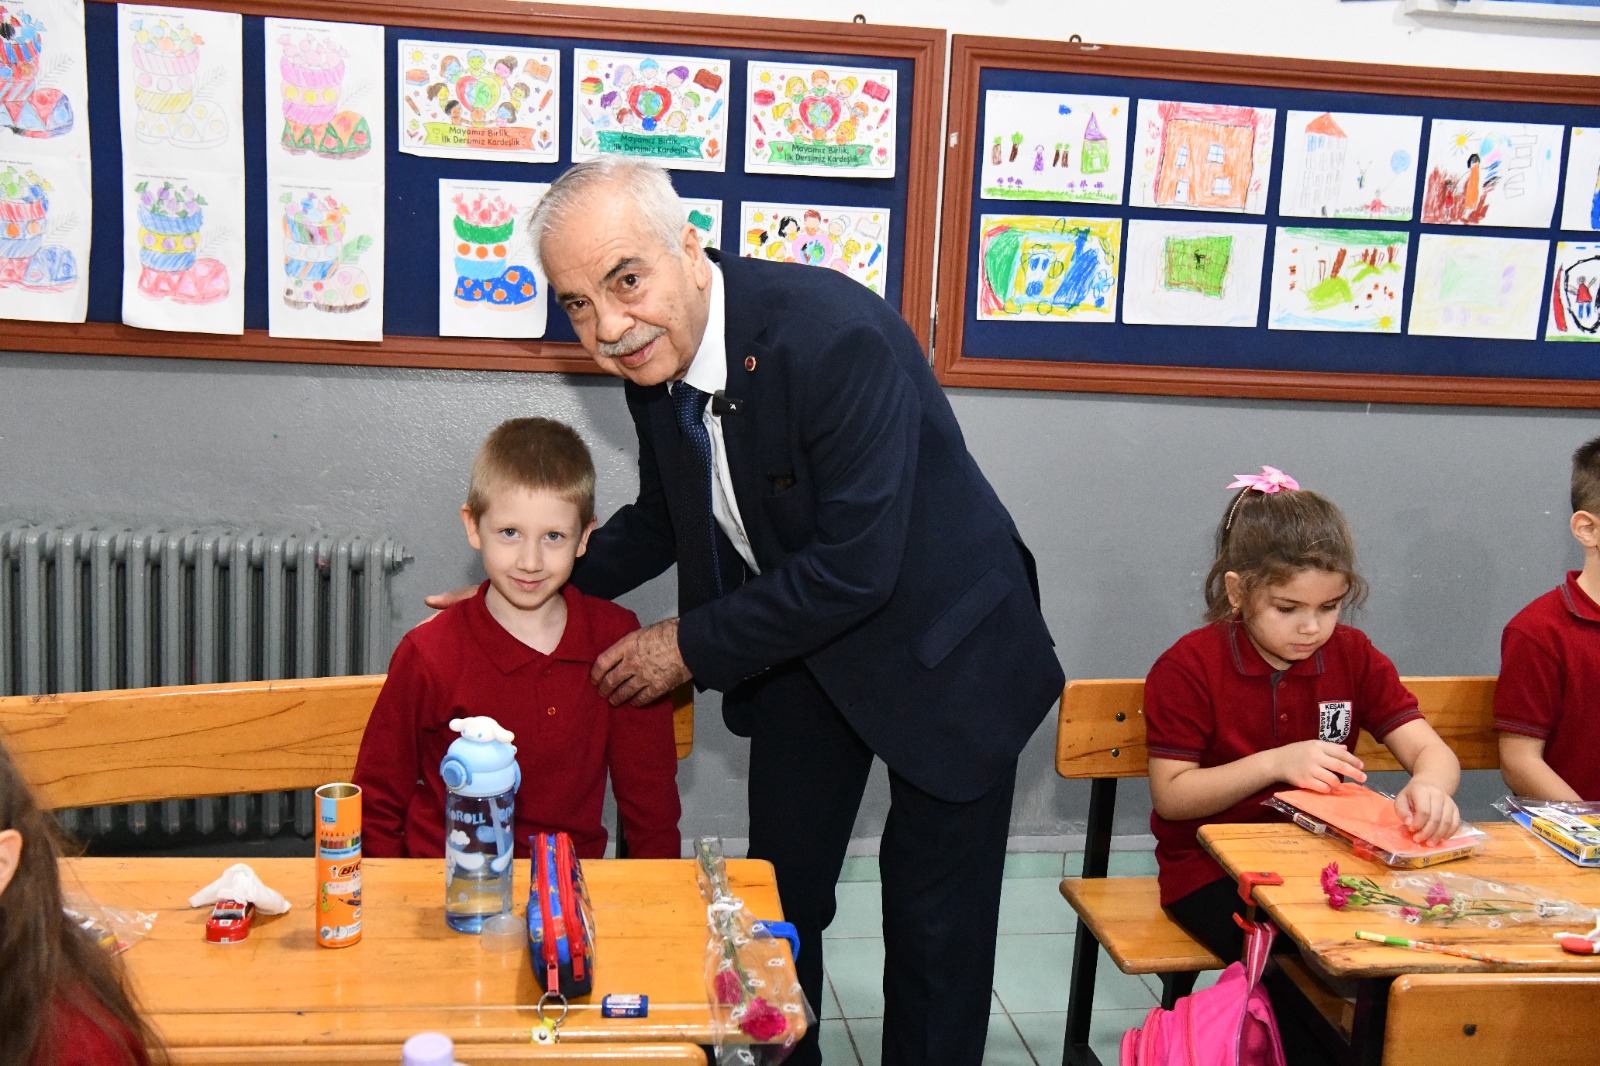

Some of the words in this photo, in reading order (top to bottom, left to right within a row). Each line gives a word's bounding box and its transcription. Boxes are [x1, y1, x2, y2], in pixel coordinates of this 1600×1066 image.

[449, 126, 485, 136] Mayamız
[453, 135, 486, 145] Dersimiz
[624, 144, 656, 154] Dersimiz
[791, 144, 826, 154] Mayamız
[795, 153, 826, 163] Dersimiz
[1325, 703, 1344, 711] KEŞAN
